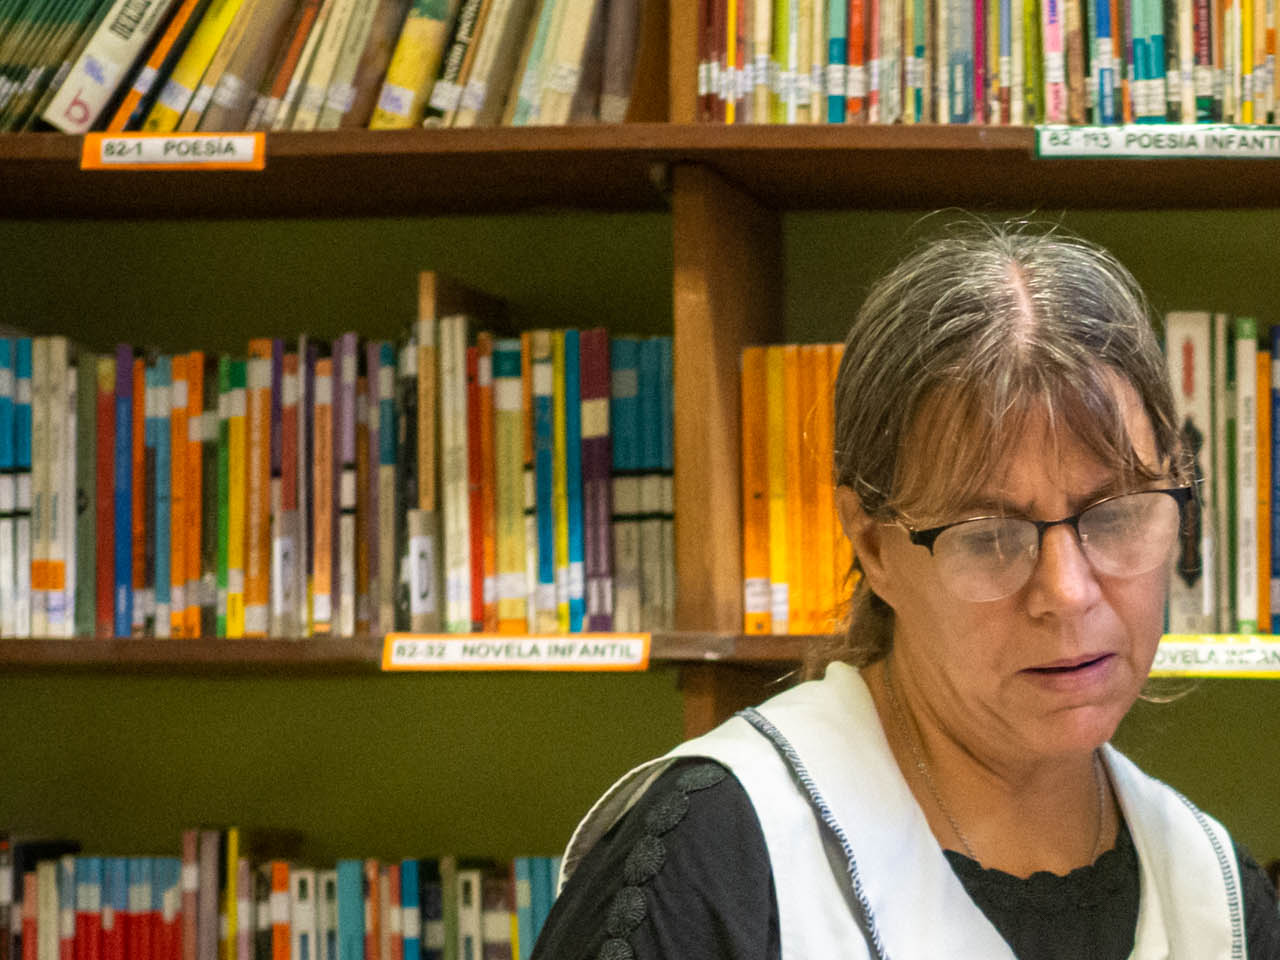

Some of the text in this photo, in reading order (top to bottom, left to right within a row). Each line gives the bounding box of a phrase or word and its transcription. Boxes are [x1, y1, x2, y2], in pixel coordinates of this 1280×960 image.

[104, 136, 236, 157] 82-1 POESÍA
[461, 643, 541, 659] NOVELA
[547, 643, 636, 659] INFANTIL
[1153, 649, 1217, 665] OVELA
